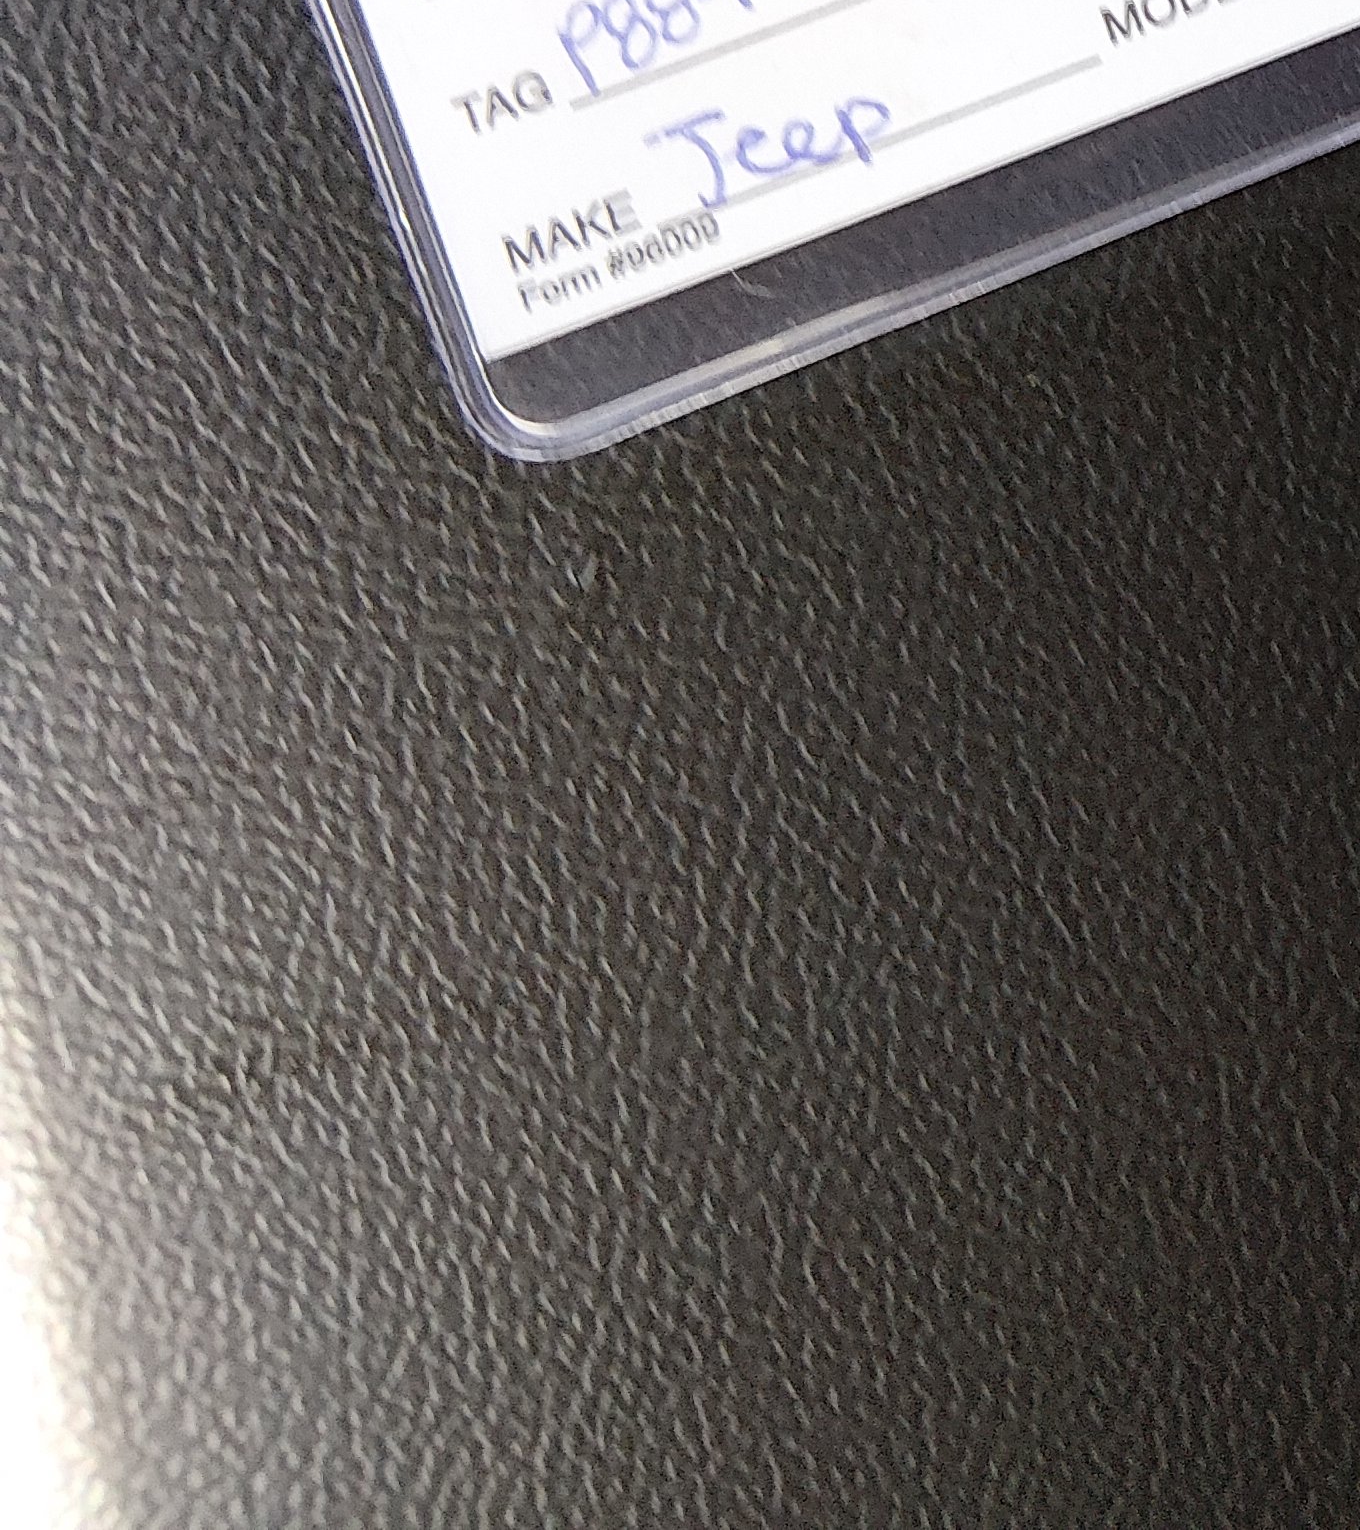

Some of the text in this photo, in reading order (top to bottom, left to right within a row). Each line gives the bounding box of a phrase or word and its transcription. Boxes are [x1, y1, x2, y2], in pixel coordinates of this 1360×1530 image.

[450, 69, 555, 136] TAG
[642, 94, 892, 210] Jeep
[501, 186, 643, 273] MAKE
[516, 264, 603, 314] Form
